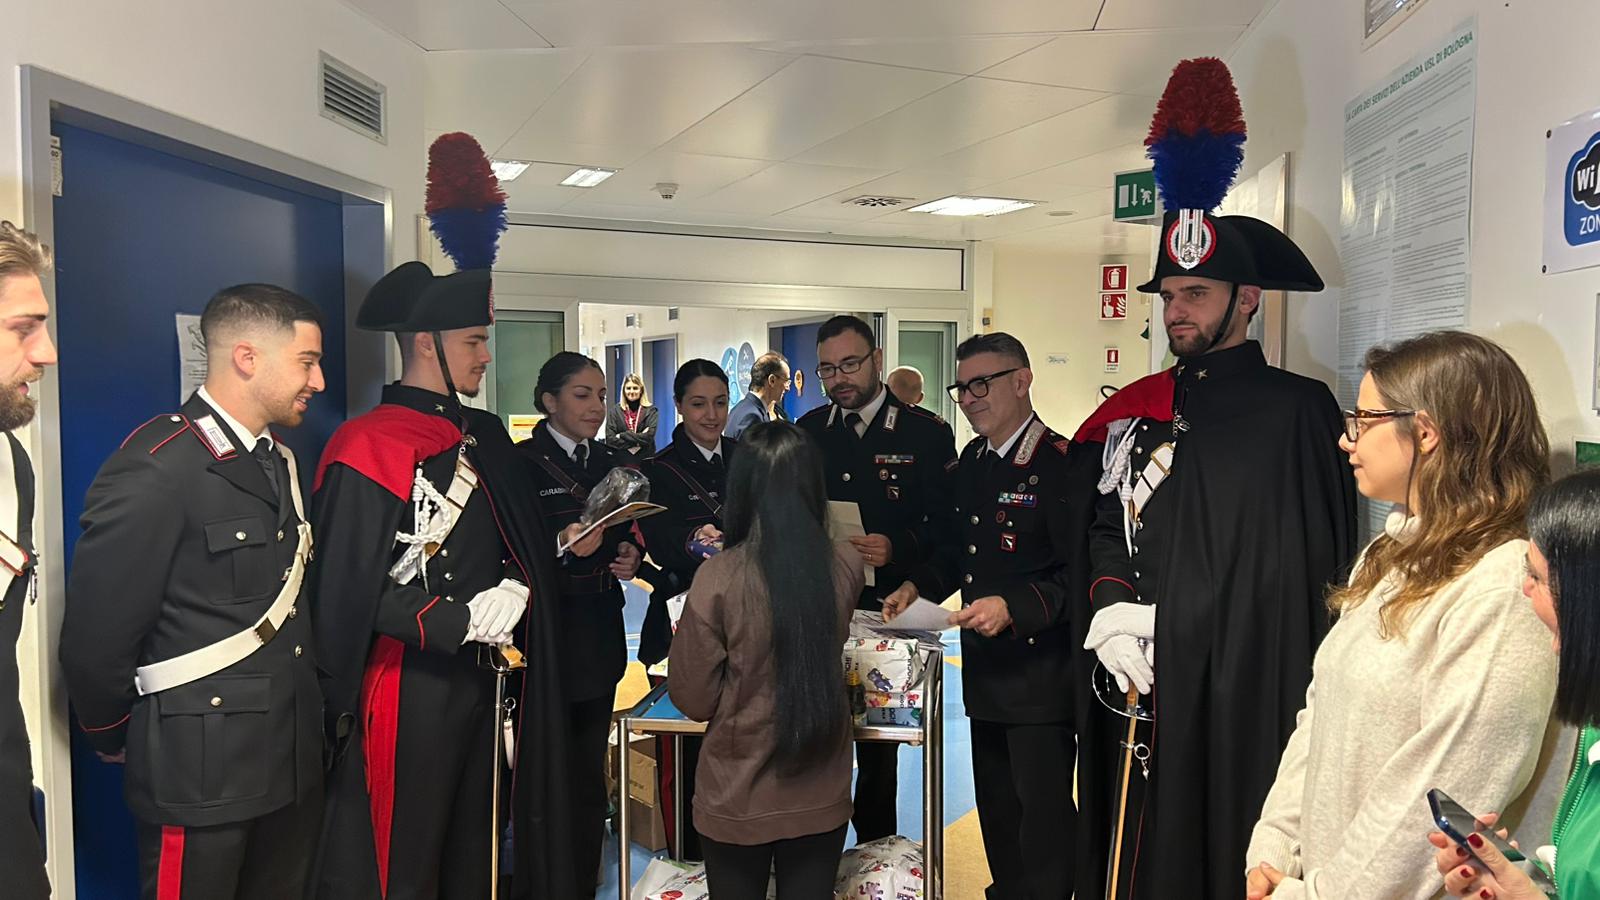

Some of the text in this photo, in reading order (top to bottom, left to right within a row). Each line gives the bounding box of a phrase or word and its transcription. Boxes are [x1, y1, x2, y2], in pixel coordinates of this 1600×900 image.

[1424, 57, 1435, 71] USL
[1436, 52, 1443, 64] DI
[1444, 31, 1473, 59] BOLOGNA
[1577, 165, 1595, 192] Wi
